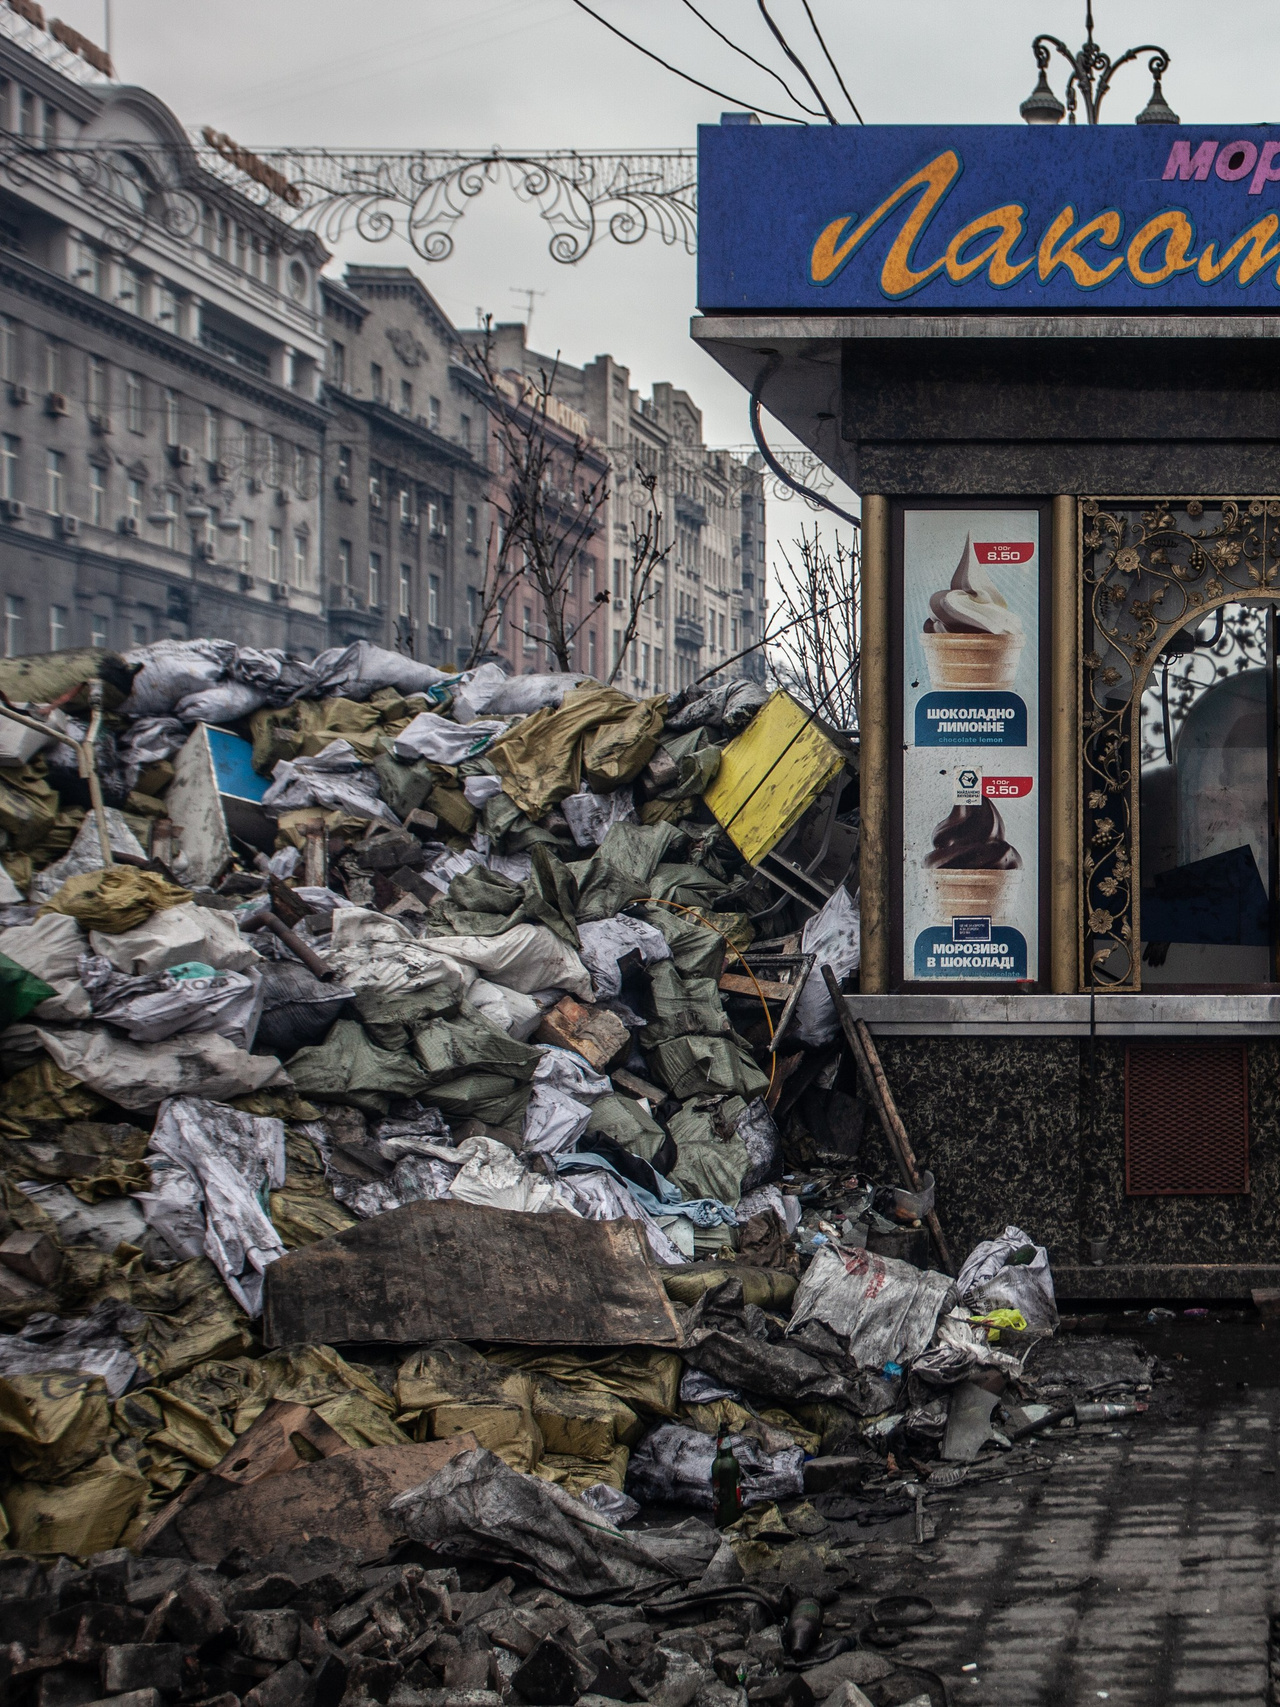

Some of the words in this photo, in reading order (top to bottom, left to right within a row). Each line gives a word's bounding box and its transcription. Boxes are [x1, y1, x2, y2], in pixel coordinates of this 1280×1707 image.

[987, 551, 1021, 561] 8.50
[927, 708, 1015, 721] ШОКОЛАДНО
[937, 721, 1005, 733] ЛИМОННЕ
[986, 785, 1019, 795] 8.50
[932, 943, 1009, 955] МОРОЗИВО
[926, 957, 936, 968] В
[940, 957, 1015, 970] ШОКОЛАДІ
